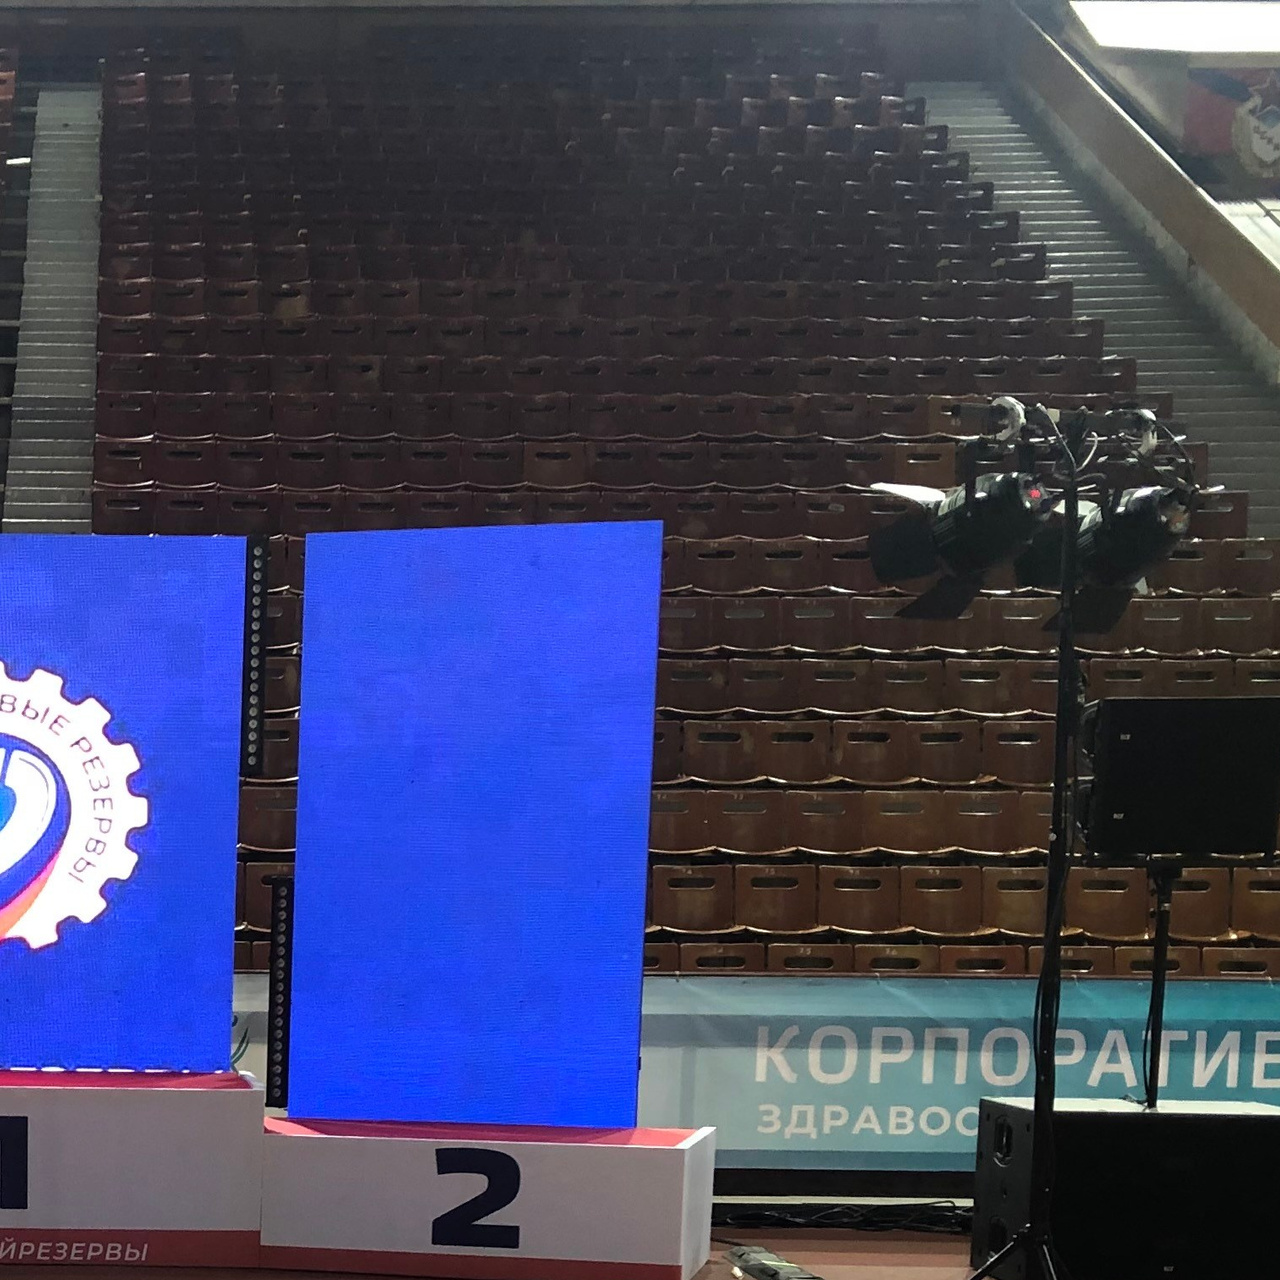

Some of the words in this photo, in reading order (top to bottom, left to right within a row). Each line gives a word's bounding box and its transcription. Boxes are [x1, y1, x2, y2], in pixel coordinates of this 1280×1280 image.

[67, 735, 114, 884] РЕЗЕРВЫ
[757, 1103, 978, 1139] ЗДРАВОС
[431, 1147, 521, 1249] 2
